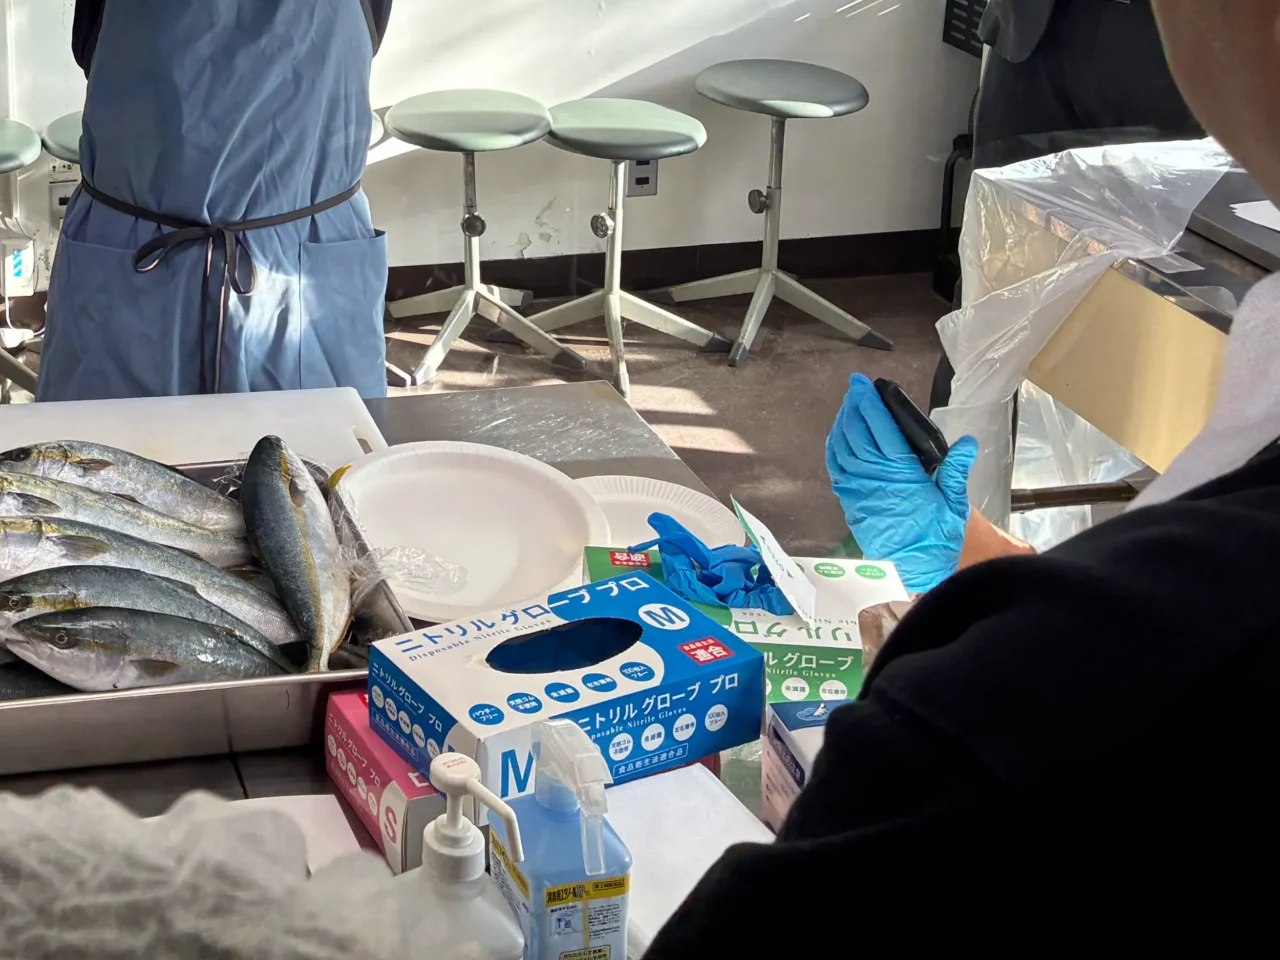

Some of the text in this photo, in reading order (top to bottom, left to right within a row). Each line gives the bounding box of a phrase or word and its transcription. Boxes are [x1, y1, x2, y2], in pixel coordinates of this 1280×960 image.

[395, 575, 651, 654] ニトリルグローブ プロ
[642, 605, 687, 628] M
[408, 618, 552, 663] Disposable Nitrile Gloves
[689, 645, 730, 662] 適合
[802, 669, 837, 679] Gloves
[372, 662, 443, 733] ニトリルグローブ プロ
[577, 672, 740, 732] ニトリルグローブ プロ
[627, 716, 656, 729] Nitrile
[658, 707, 687, 720] Gloves
[618, 747, 685, 775] 食品衛生法適合品
[383, 805, 398, 844] S
